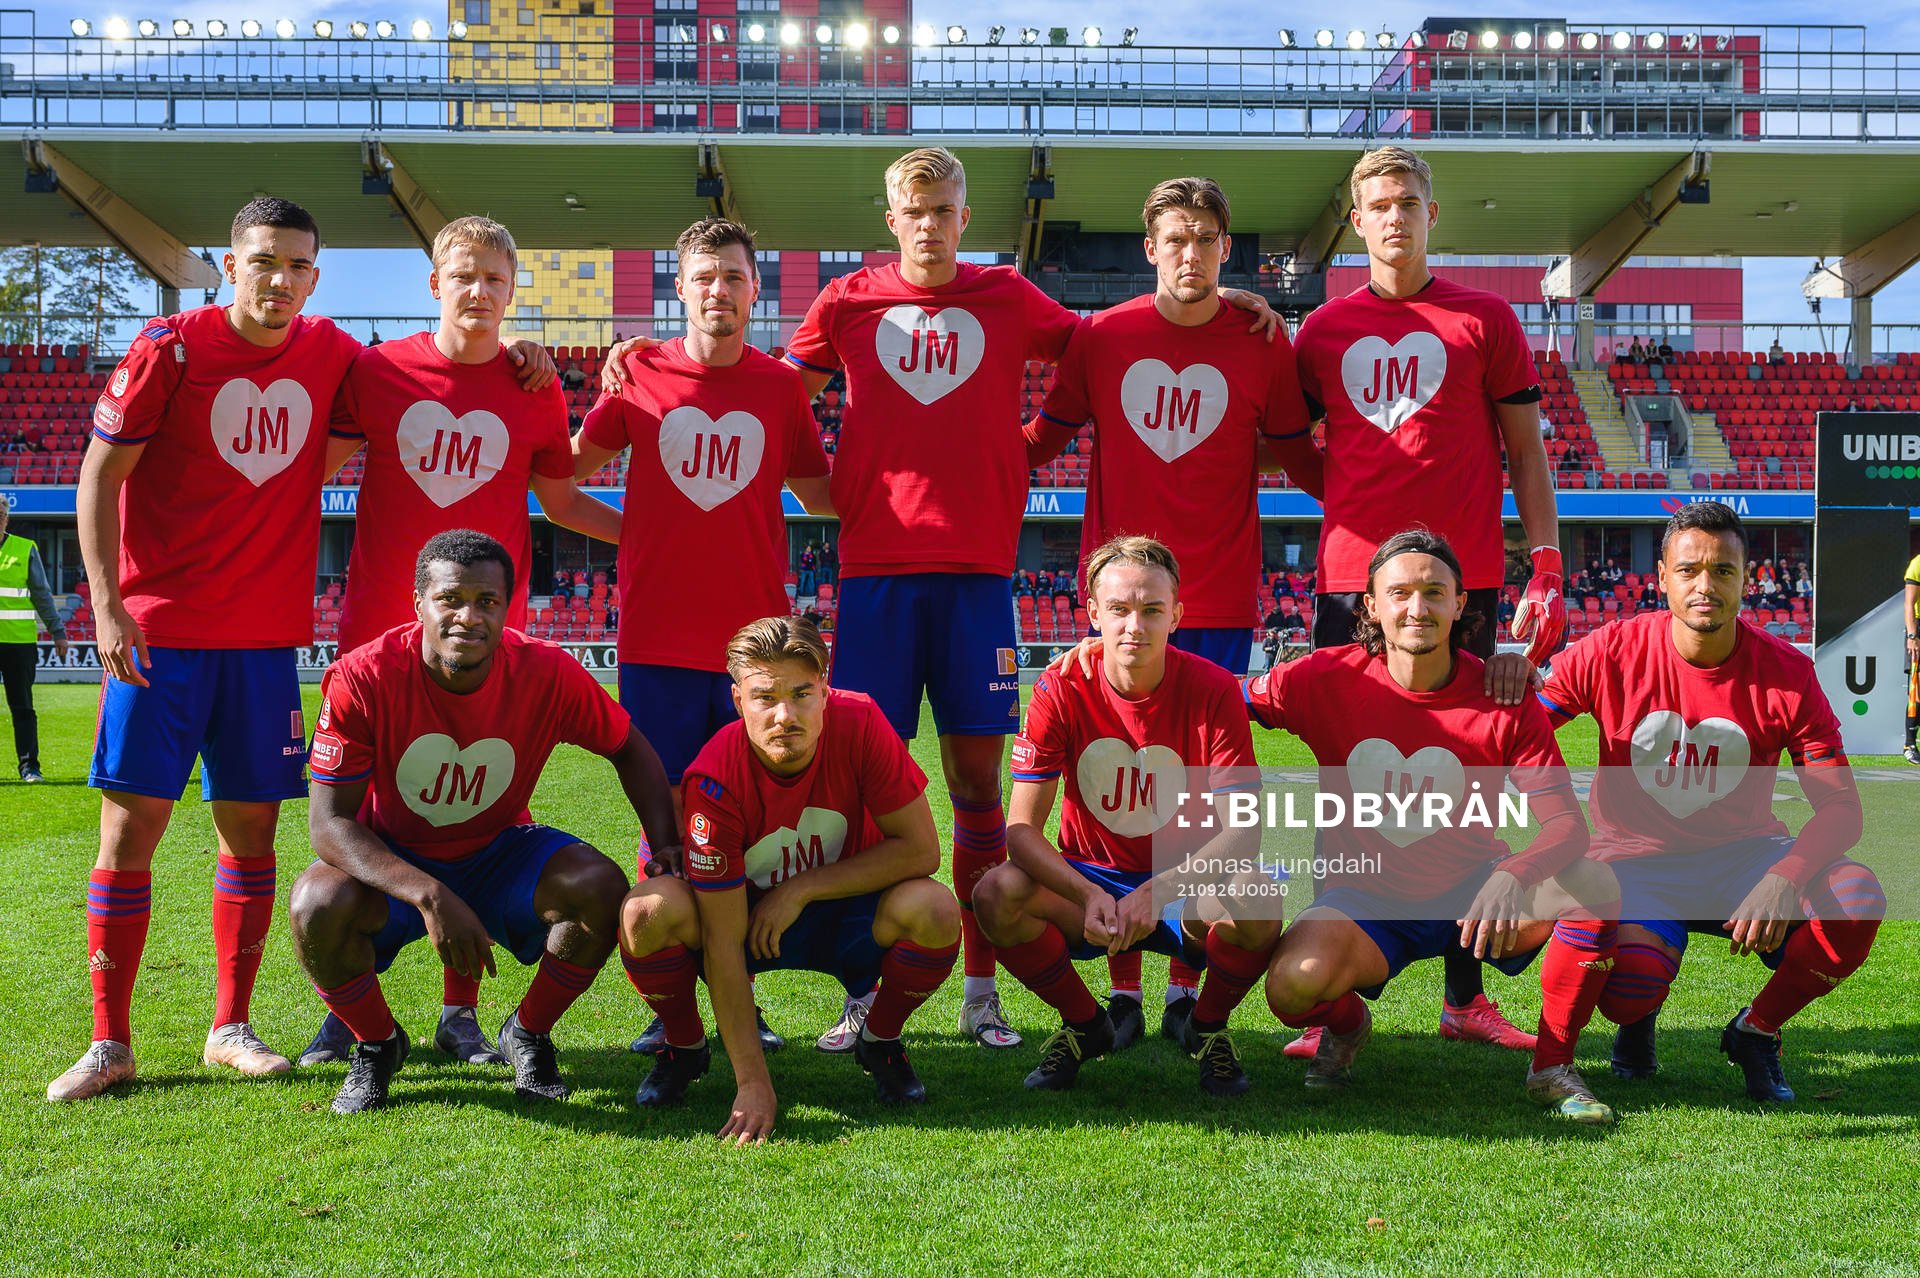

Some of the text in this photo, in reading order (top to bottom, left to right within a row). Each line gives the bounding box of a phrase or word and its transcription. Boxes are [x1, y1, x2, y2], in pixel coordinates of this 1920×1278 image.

[898, 329, 959, 376] JM
[1362, 354, 1419, 404] JM
[232, 406, 289, 455] JM
[1143, 385, 1202, 434] JM
[419, 429, 483, 479] JM
[681, 432, 742, 482] JM
[1843, 434, 1920, 461] UNIB
[419, 762, 487, 806] JM
[1101, 764, 1156, 813] JM
[1654, 740, 1720, 793] JM
[1381, 768, 1434, 816] JM
[688, 850, 722, 865] UNIBET
[770, 834, 825, 886] JM
